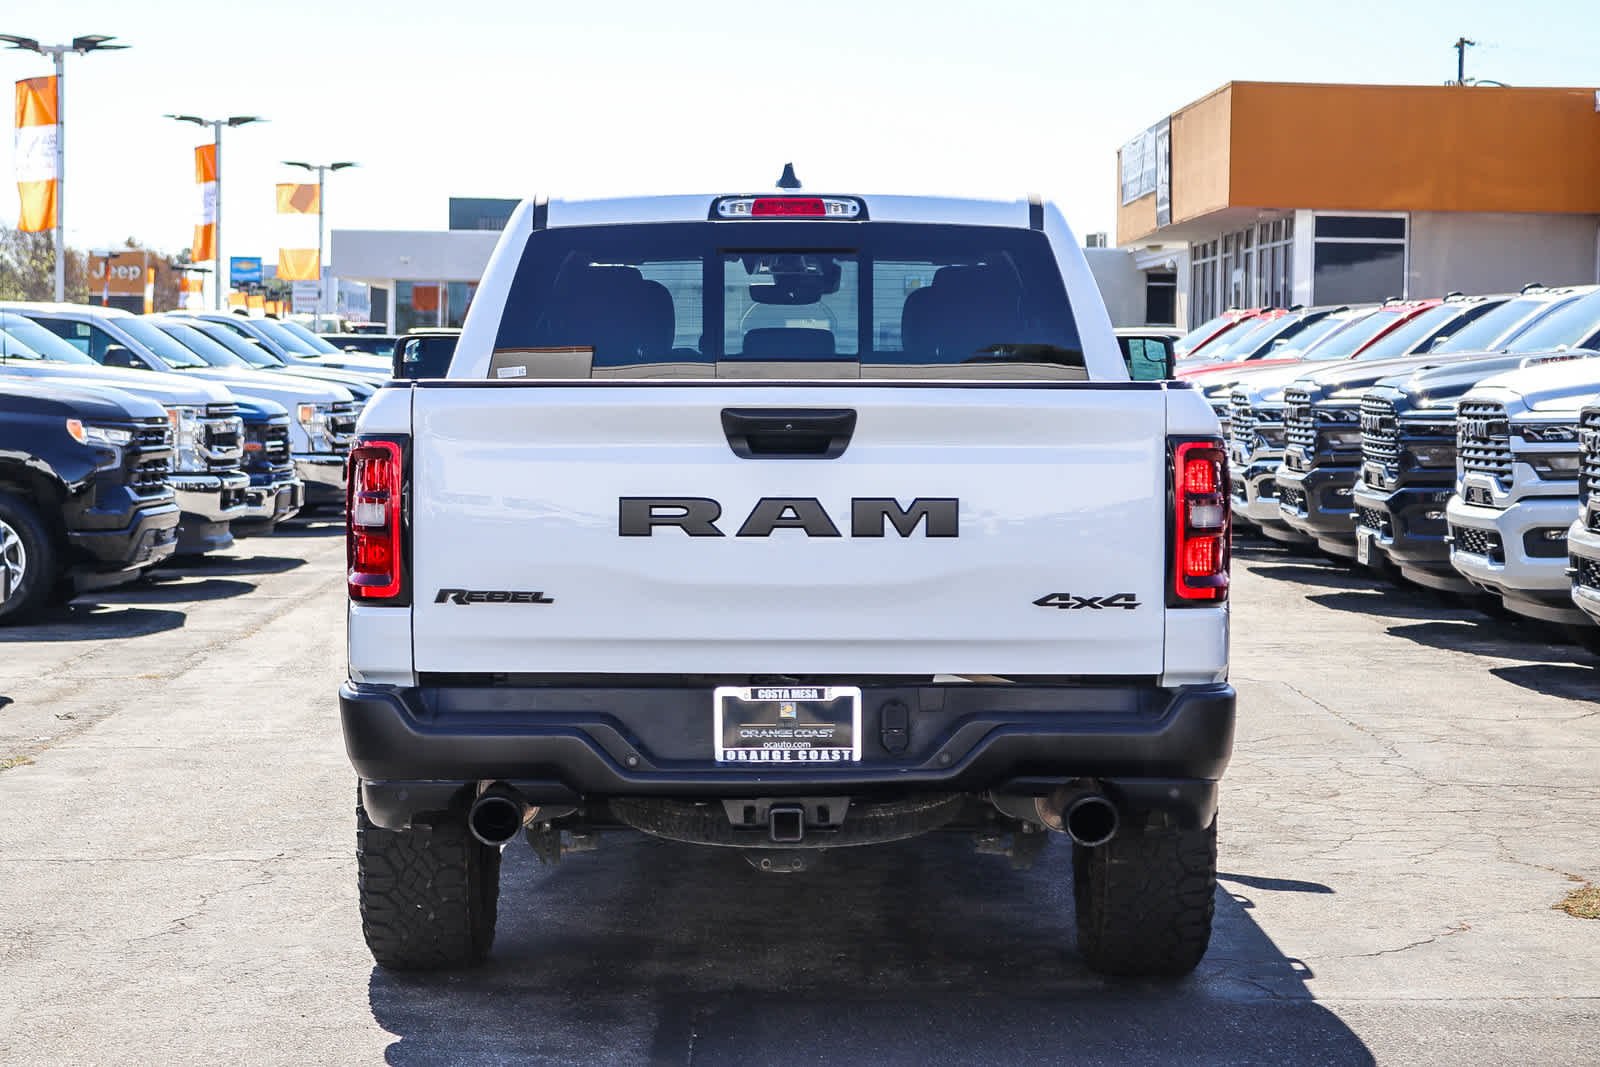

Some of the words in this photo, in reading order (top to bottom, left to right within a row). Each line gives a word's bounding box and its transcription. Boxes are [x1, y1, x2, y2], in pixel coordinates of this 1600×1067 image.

[1460, 420, 1487, 438] RAM
[619, 497, 959, 537] RAM
[1032, 592, 1142, 609] 4x4
[757, 689, 790, 699] COSTA
[791, 689, 818, 699] MESA
[740, 729, 793, 738] ORANGE
[794, 729, 835, 738] COAST
[763, 741, 811, 749] ocauto.com
[726, 750, 791, 761] ORANGE
[798, 750, 851, 761] COAST
